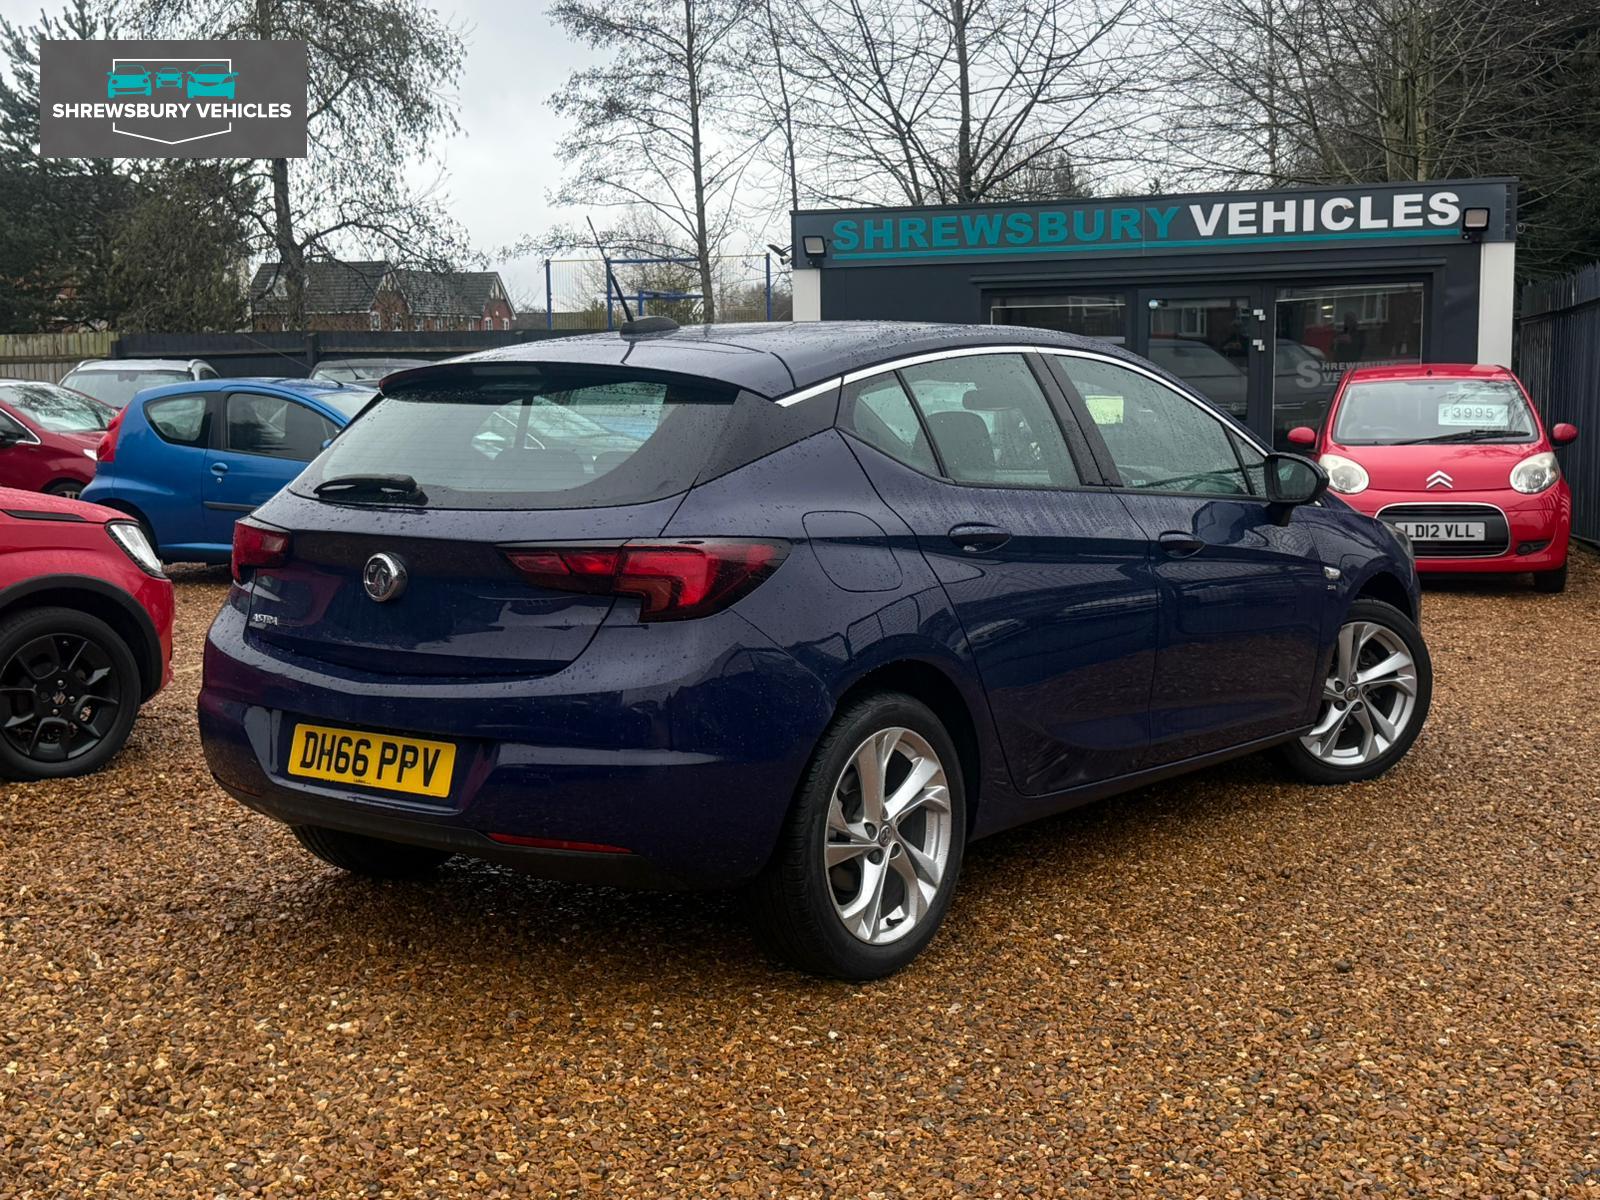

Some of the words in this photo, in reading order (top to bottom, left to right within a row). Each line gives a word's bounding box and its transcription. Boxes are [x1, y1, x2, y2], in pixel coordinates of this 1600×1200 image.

[832, 206, 1180, 251] SHREWSBURY
[1188, 192, 1461, 236] VEHICLES
[1404, 524, 1440, 538] LD12
[1444, 524, 1476, 538] VLL
[299, 731, 372, 777] DH66
[376, 741, 442, 788] PPV
